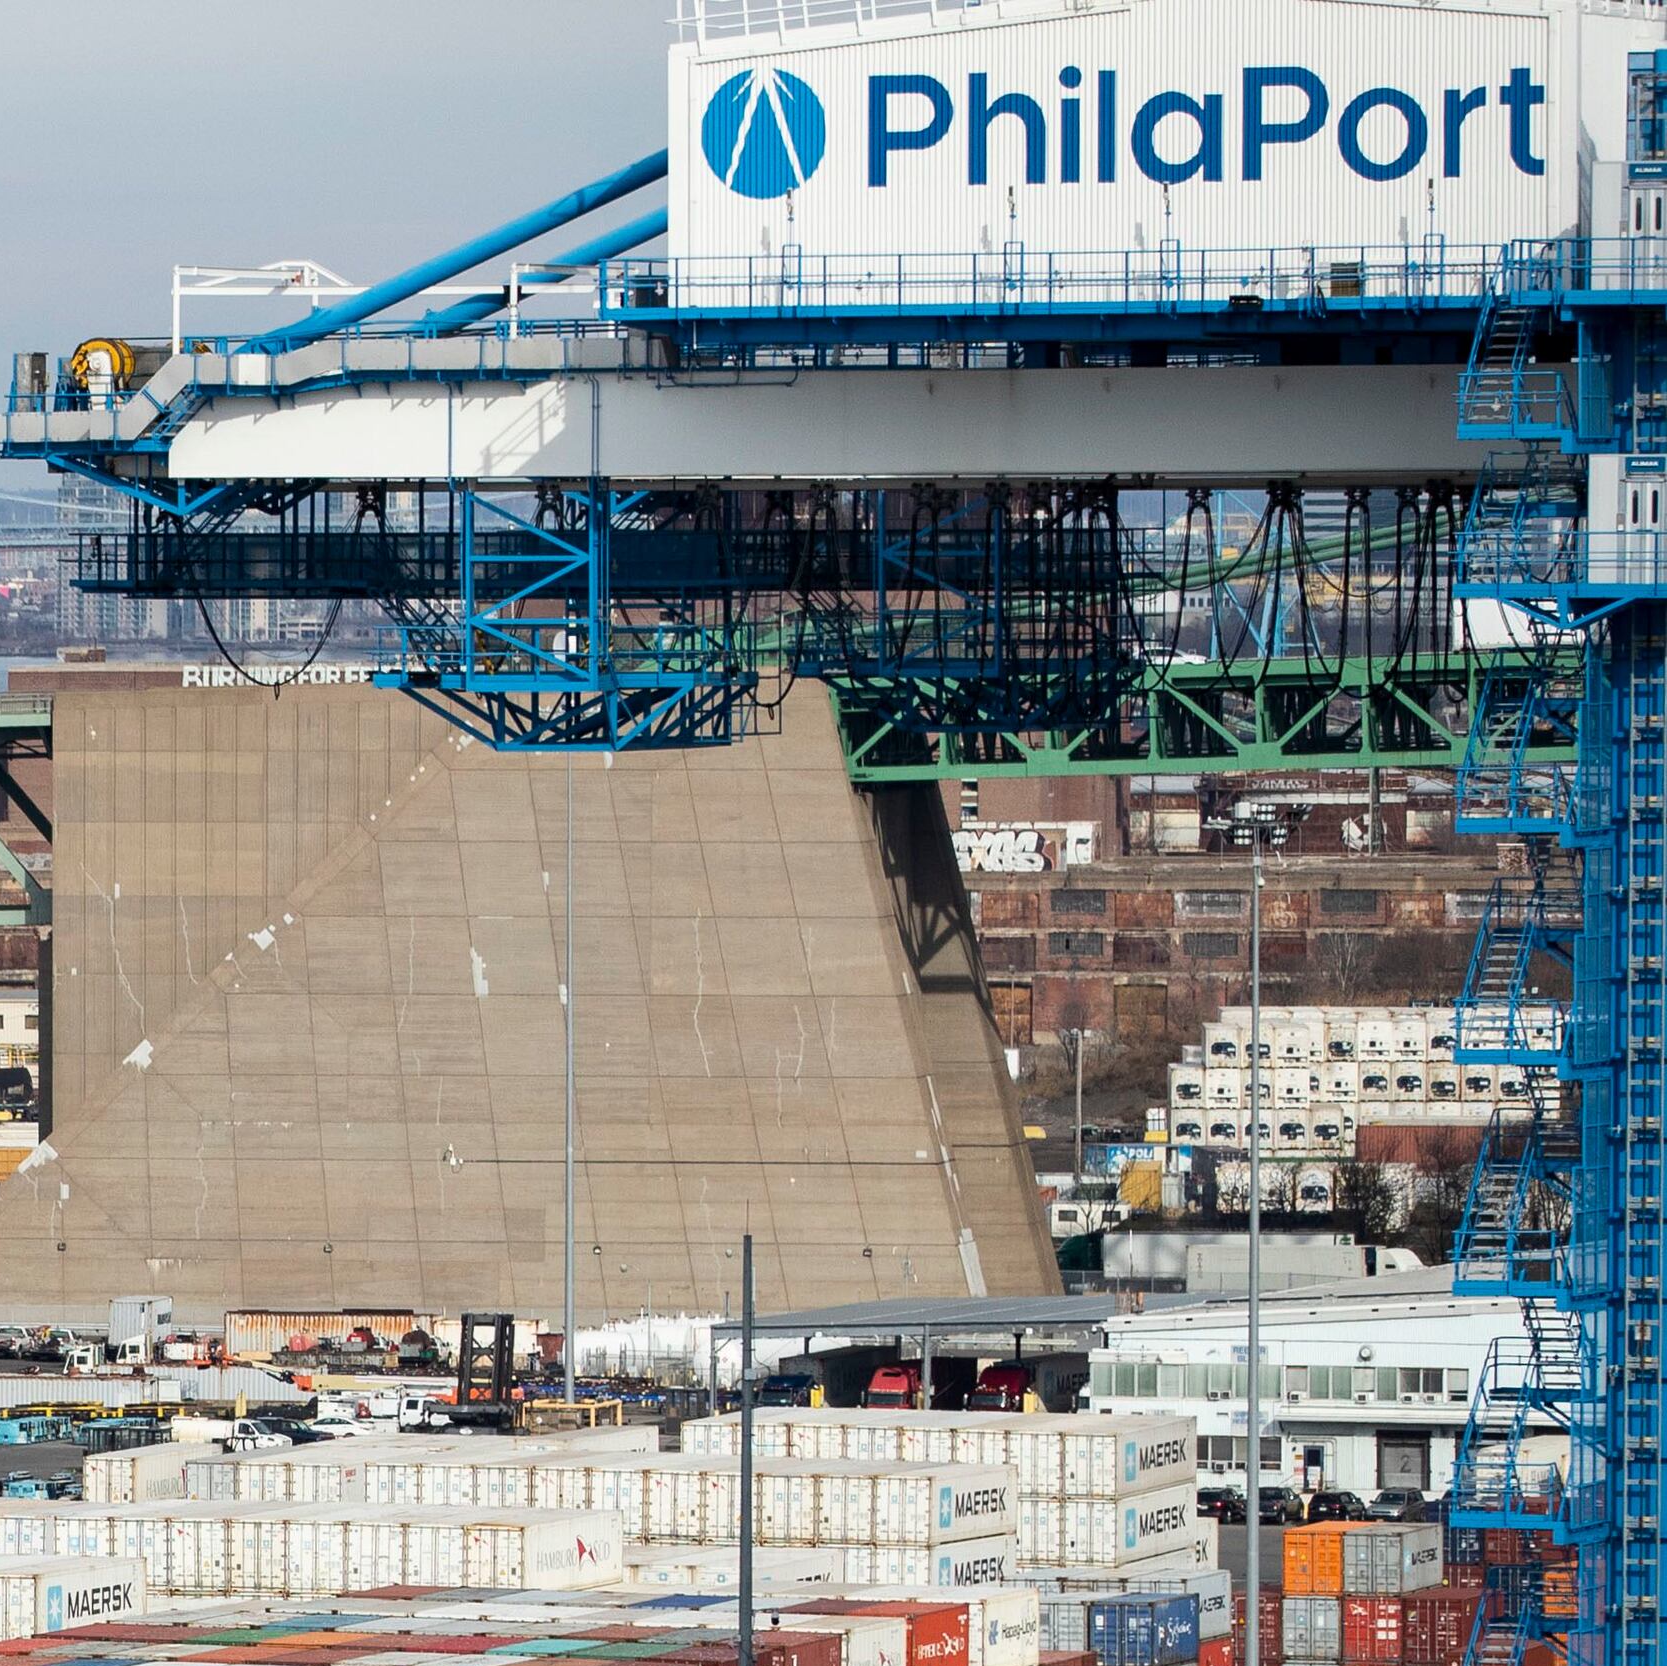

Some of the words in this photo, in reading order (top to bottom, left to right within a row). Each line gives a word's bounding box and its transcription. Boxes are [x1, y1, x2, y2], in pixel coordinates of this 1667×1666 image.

[867, 66, 1546, 187] PhilaPort
[297, 665, 341, 684] FOR
[1139, 1440, 1186, 1471] MAERSK
[1400, 1456, 1413, 1473] 2
[955, 1489, 1006, 1519] MAERSK
[1139, 1505, 1186, 1536] MAERSK
[954, 1556, 1005, 1585] MAERSK
[68, 1582, 132, 1619] MAERSK
